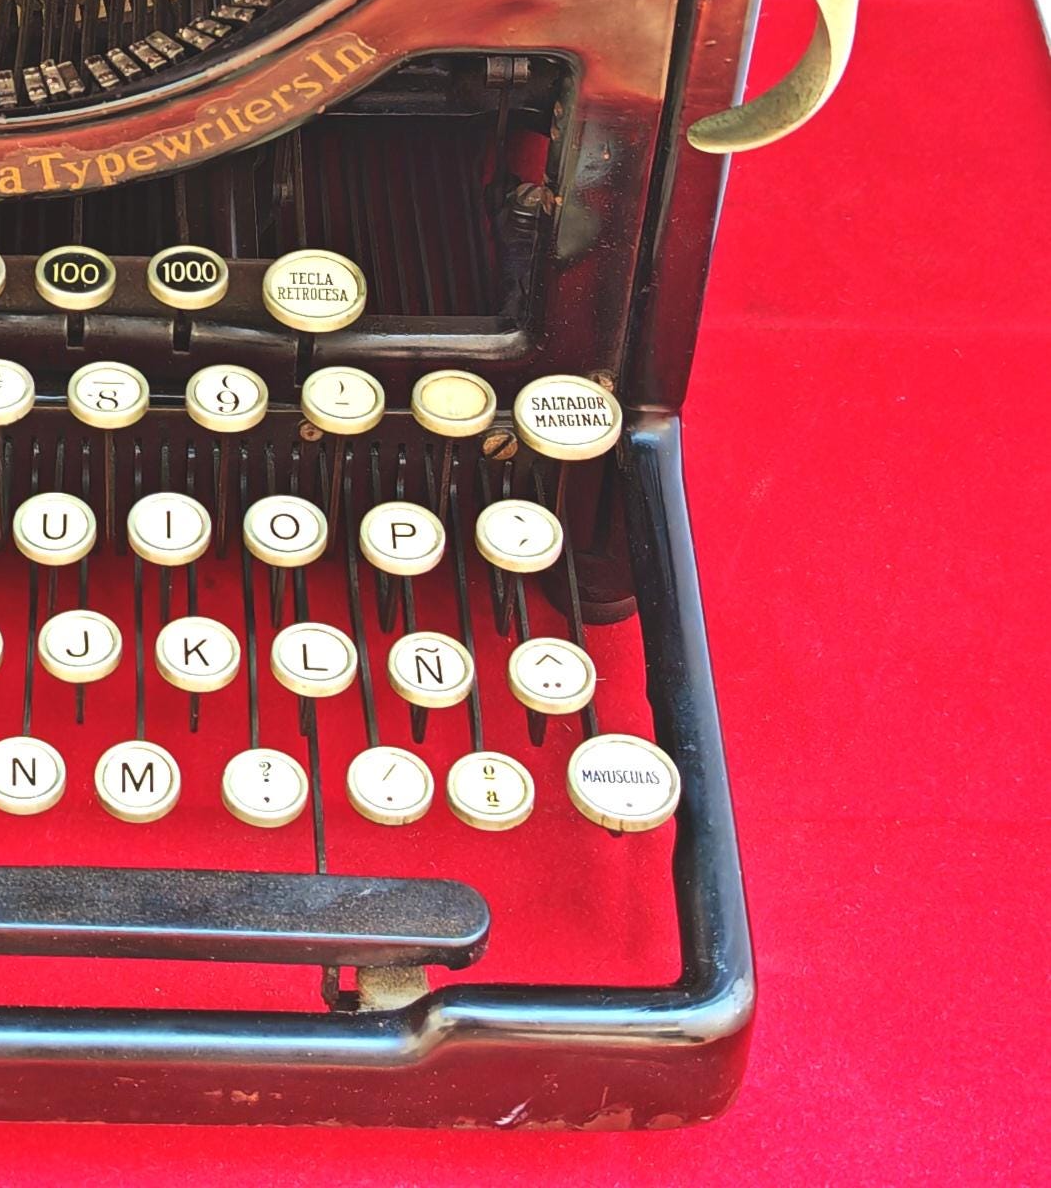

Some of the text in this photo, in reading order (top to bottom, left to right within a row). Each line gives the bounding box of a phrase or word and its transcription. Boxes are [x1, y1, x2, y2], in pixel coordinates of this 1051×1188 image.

[26, 70, 325, 193] Typewriters
[52, 261, 100, 285] 100
[289, 272, 334, 286] TECLA
[277, 286, 350, 303] RETROCESA
[95, 389, 119, 412] 8
[215, 390, 240, 413] 9
[531, 396, 607, 411] SALTADOR
[535, 414, 613, 428] MARGINAL
[42, 513, 68, 540] U
[269, 513, 300, 540] O
[390, 522, 417, 550] P
[65, 630, 90, 658] J
[183, 637, 210, 667] K
[302, 643, 329, 672] L
[414, 647, 444, 685] Ñ
[11, 757, 36, 787] N
[121, 762, 154, 793] M
[581, 769, 661, 785] MAYUSCULAS
